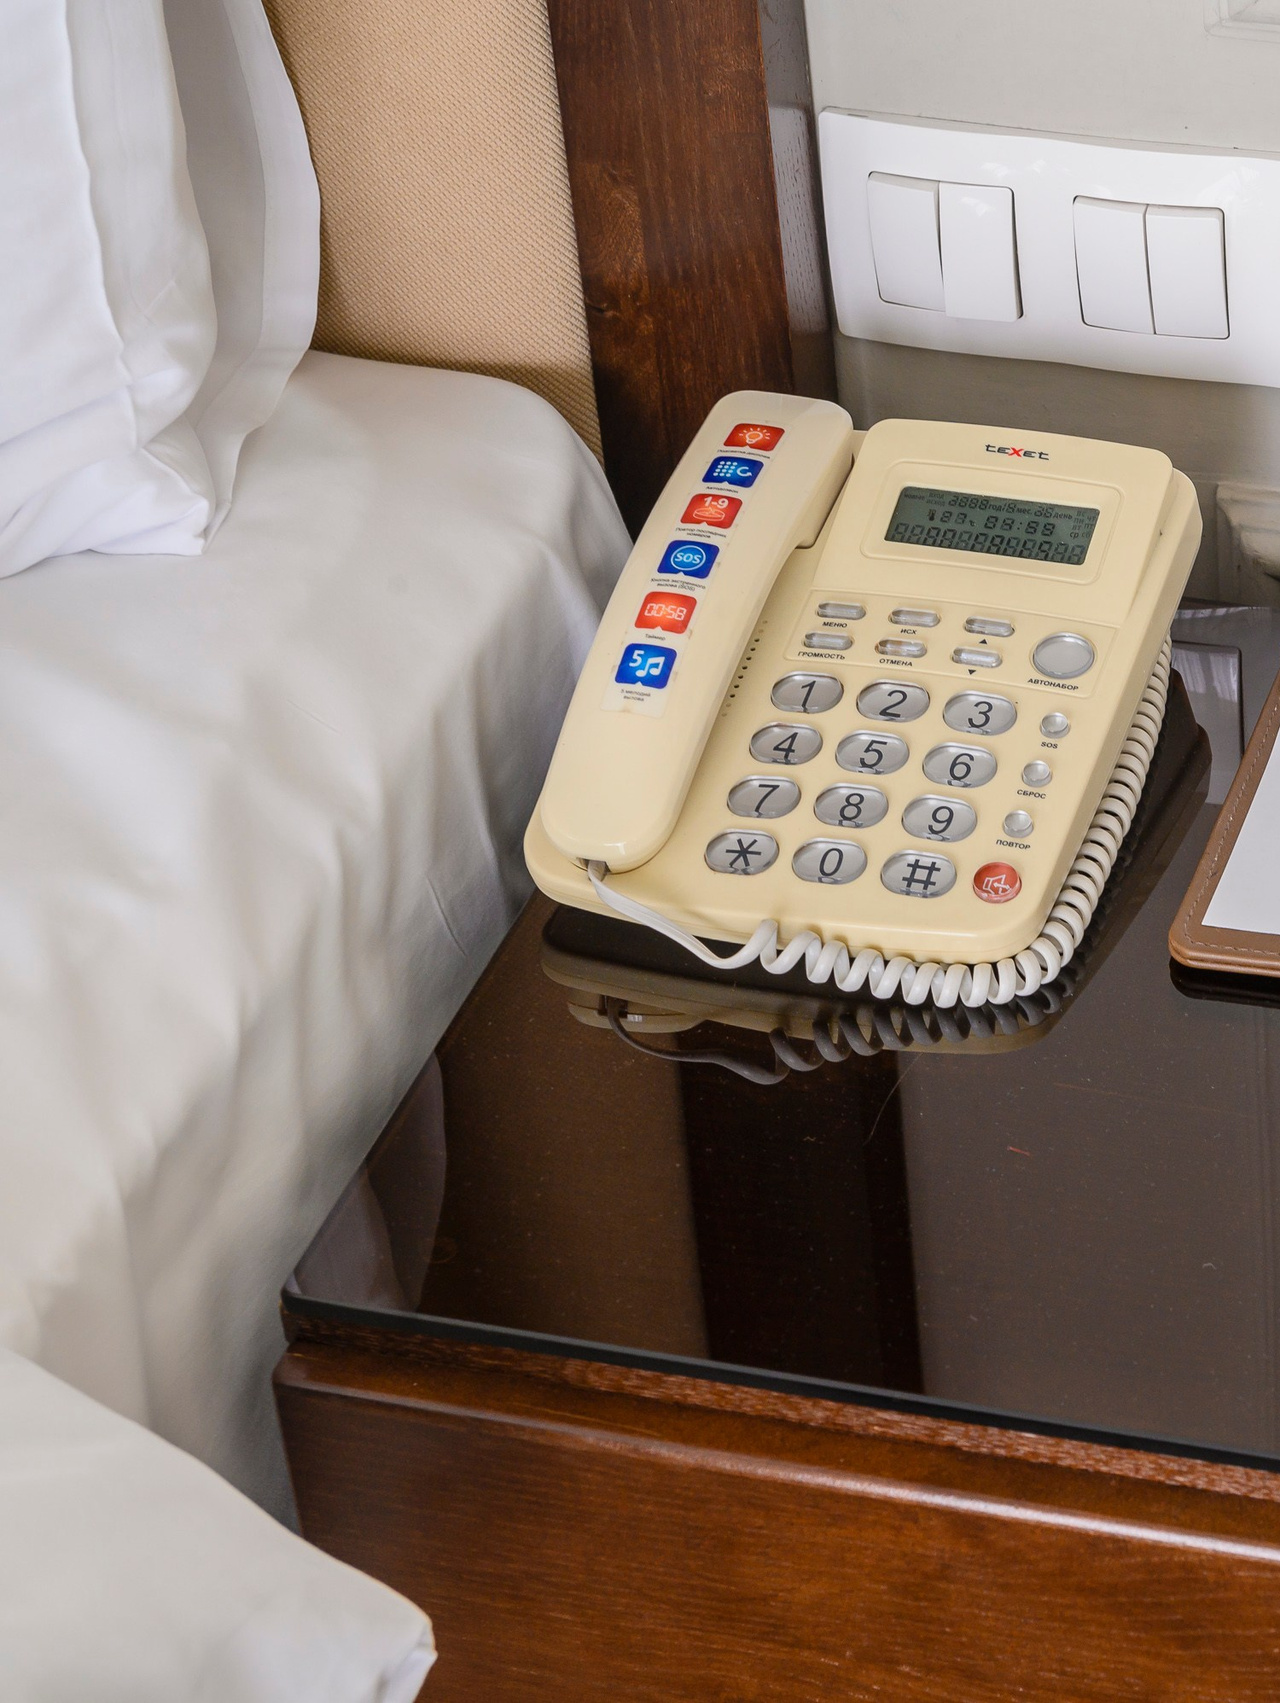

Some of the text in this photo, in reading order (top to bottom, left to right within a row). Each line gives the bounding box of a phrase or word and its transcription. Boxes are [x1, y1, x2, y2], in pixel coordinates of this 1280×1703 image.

[704, 496, 729, 509] 1-9
[674, 552, 702, 564] SOS
[628, 649, 645, 668] 5
[797, 651, 846, 660] ГРОМКОСТЬ
[879, 658, 913, 667] ОТМЕНА
[800, 680, 817, 710] 1
[1027, 678, 1079, 691] АВТОНАБОР
[879, 689, 908, 718] 2
[967, 701, 994, 729] 3
[772, 732, 799, 760] 4
[859, 739, 888, 769] 5
[1040, 741, 1058, 749] SOS
[949, 752, 975, 781] 6
[754, 783, 780, 814] 7
[839, 792, 865, 821] 8
[1016, 789, 1047, 799] СБРОС
[927, 805, 955, 834] 9
[995, 839, 1031, 850] ПОВТОР
[819, 847, 844, 877] 0
